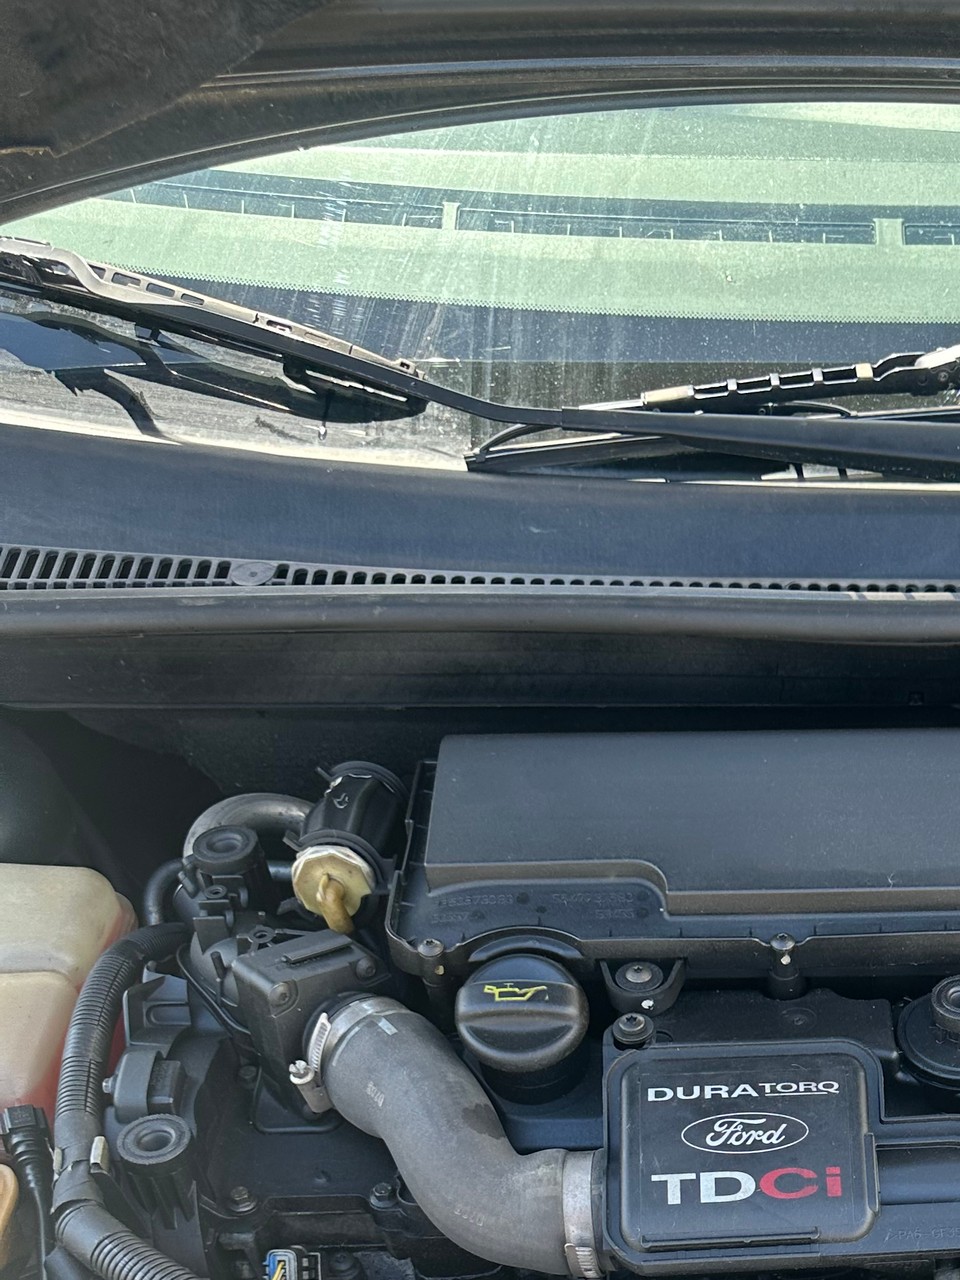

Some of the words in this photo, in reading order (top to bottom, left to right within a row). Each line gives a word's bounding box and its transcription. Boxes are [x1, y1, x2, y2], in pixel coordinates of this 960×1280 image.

[647, 1081, 840, 1102] DURATORQ
[705, 1117, 788, 1148] Ford
[651, 1166, 842, 1205] TDCi
